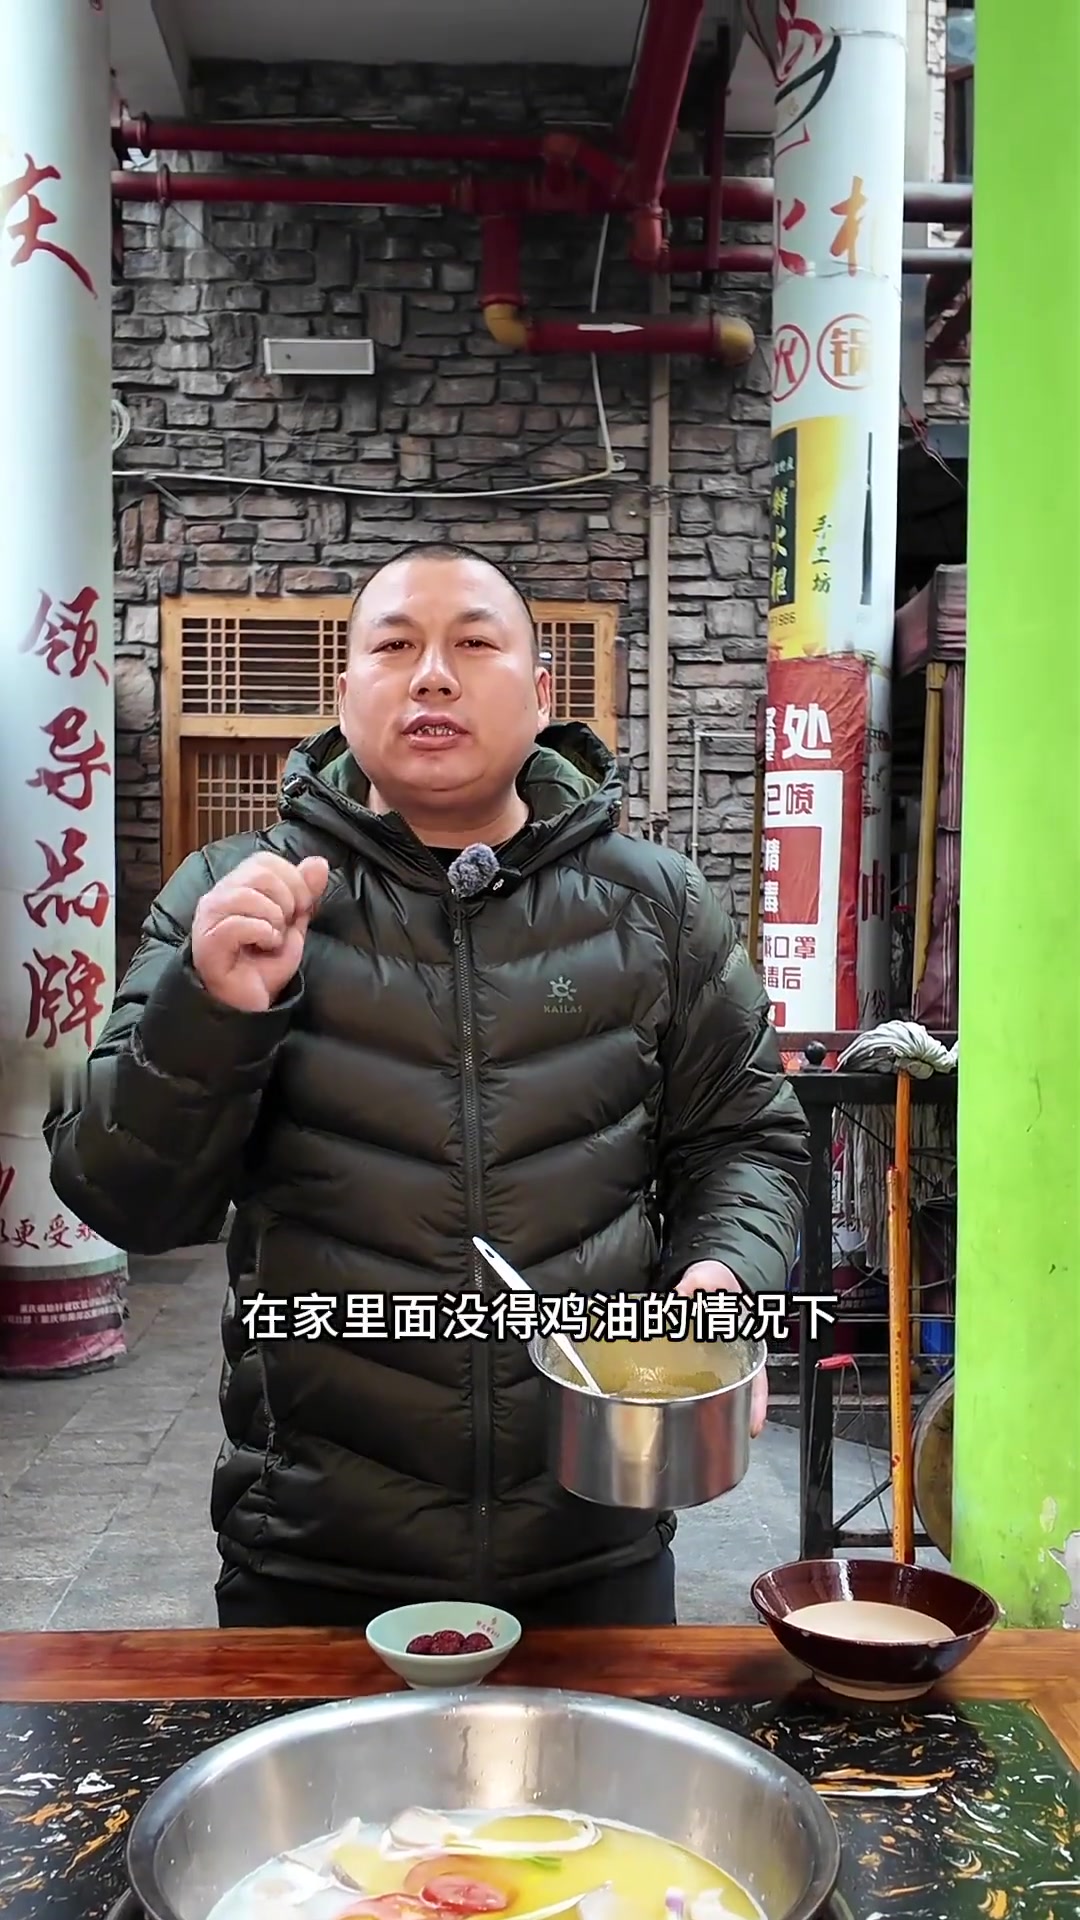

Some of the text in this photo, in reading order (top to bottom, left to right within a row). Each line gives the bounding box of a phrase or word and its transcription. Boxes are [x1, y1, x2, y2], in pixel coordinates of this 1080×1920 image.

[811, 514, 831, 593] 手工坊
[18, 586, 111, 1052] 领导品牌
[543, 1004, 583, 1015] KAILAS
